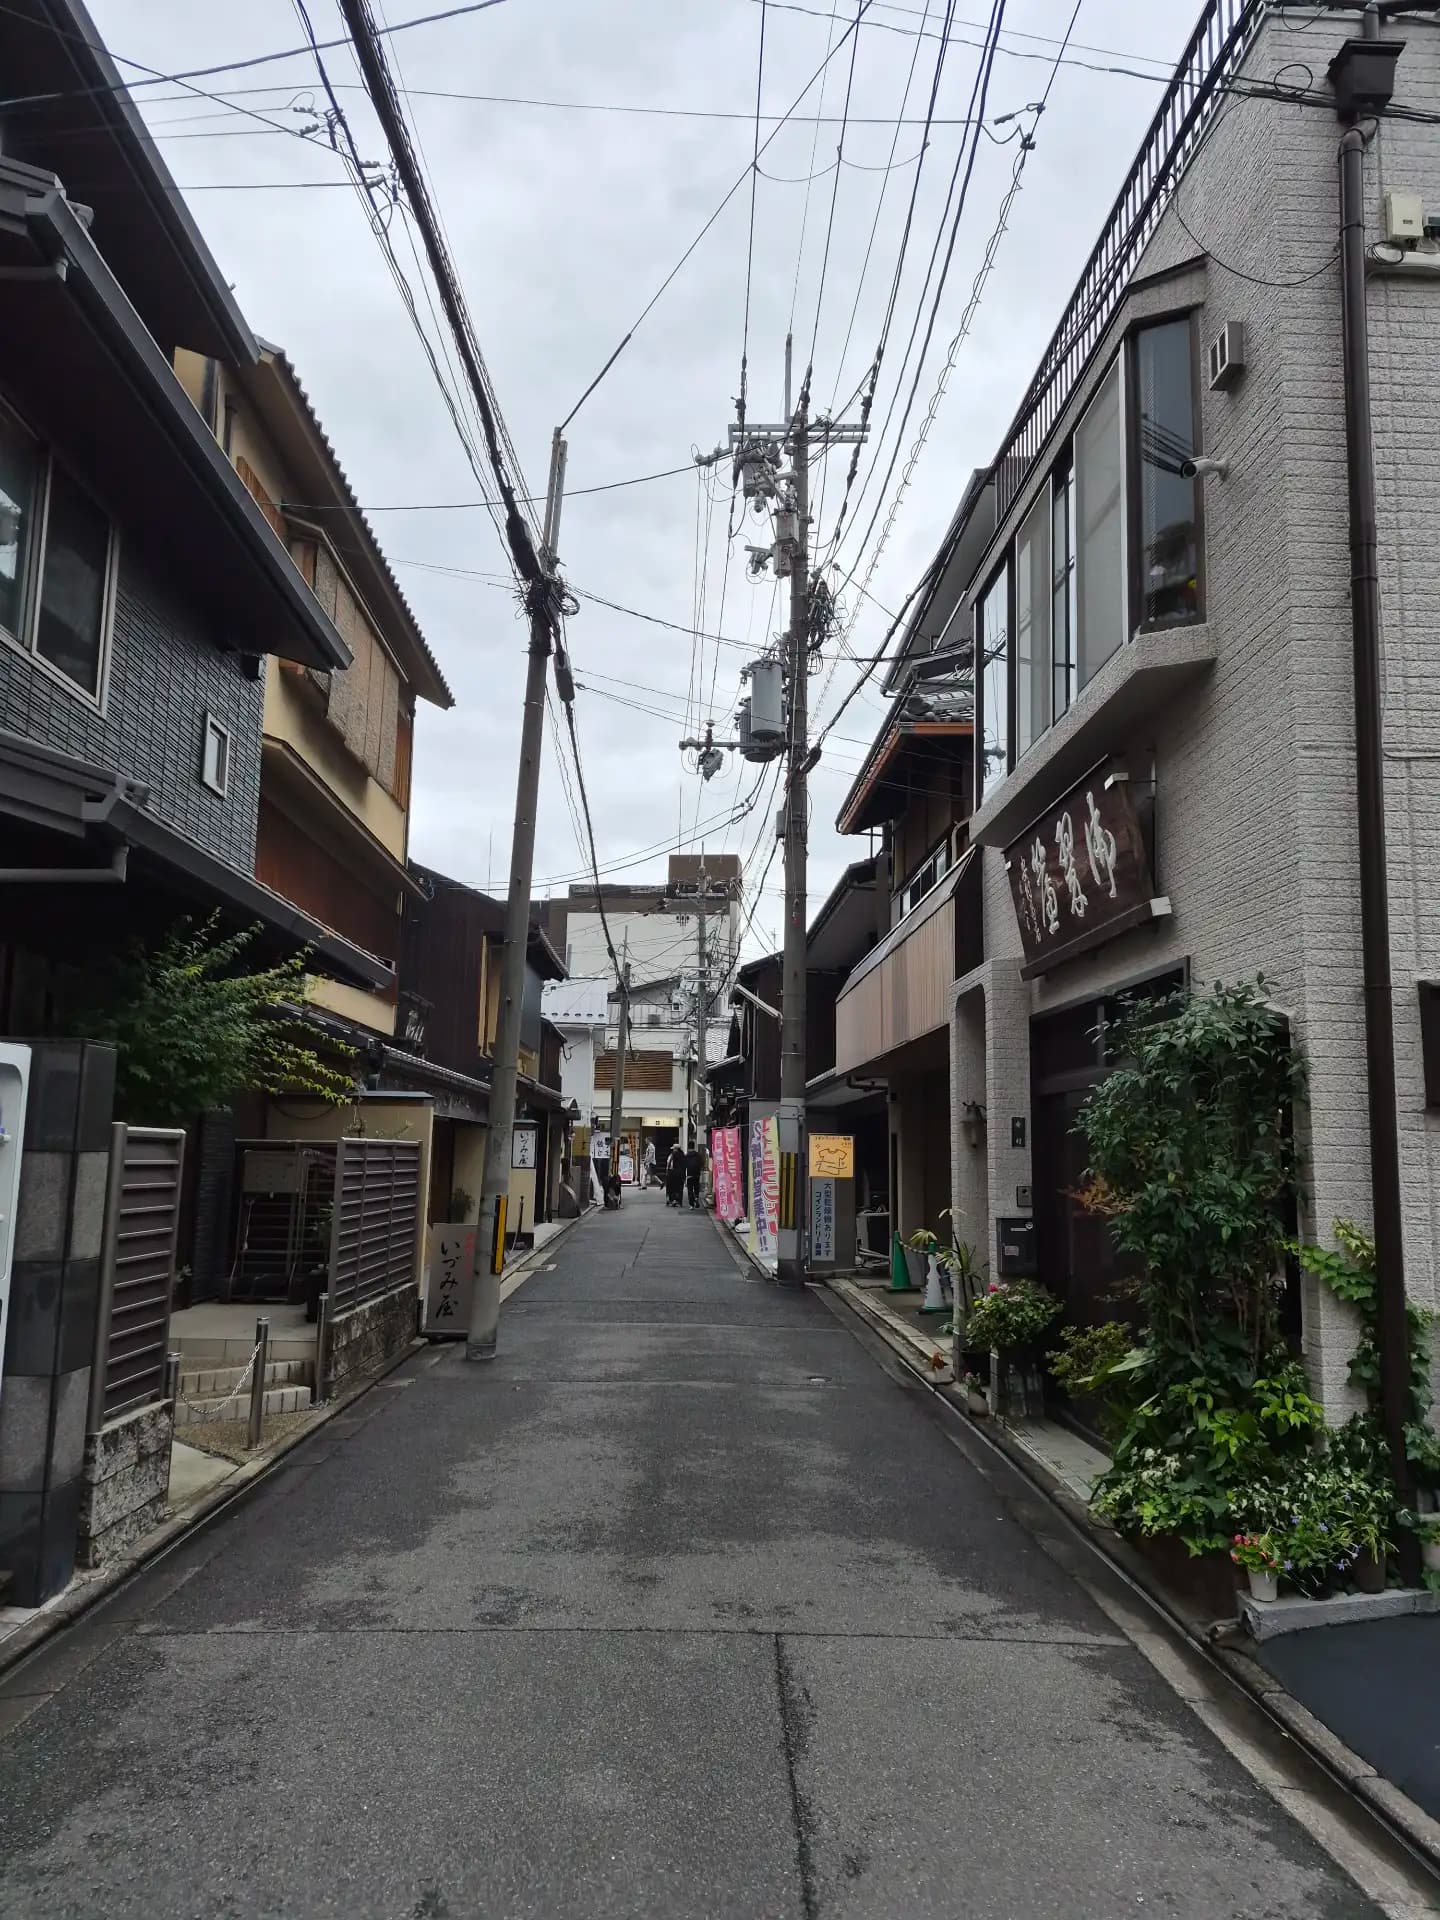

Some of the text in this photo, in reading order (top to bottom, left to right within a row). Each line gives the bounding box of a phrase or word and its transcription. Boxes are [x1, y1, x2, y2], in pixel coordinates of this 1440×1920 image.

[518, 1131, 529, 1165] いづみ屋
[436, 1240, 460, 1319] いづみ屋
